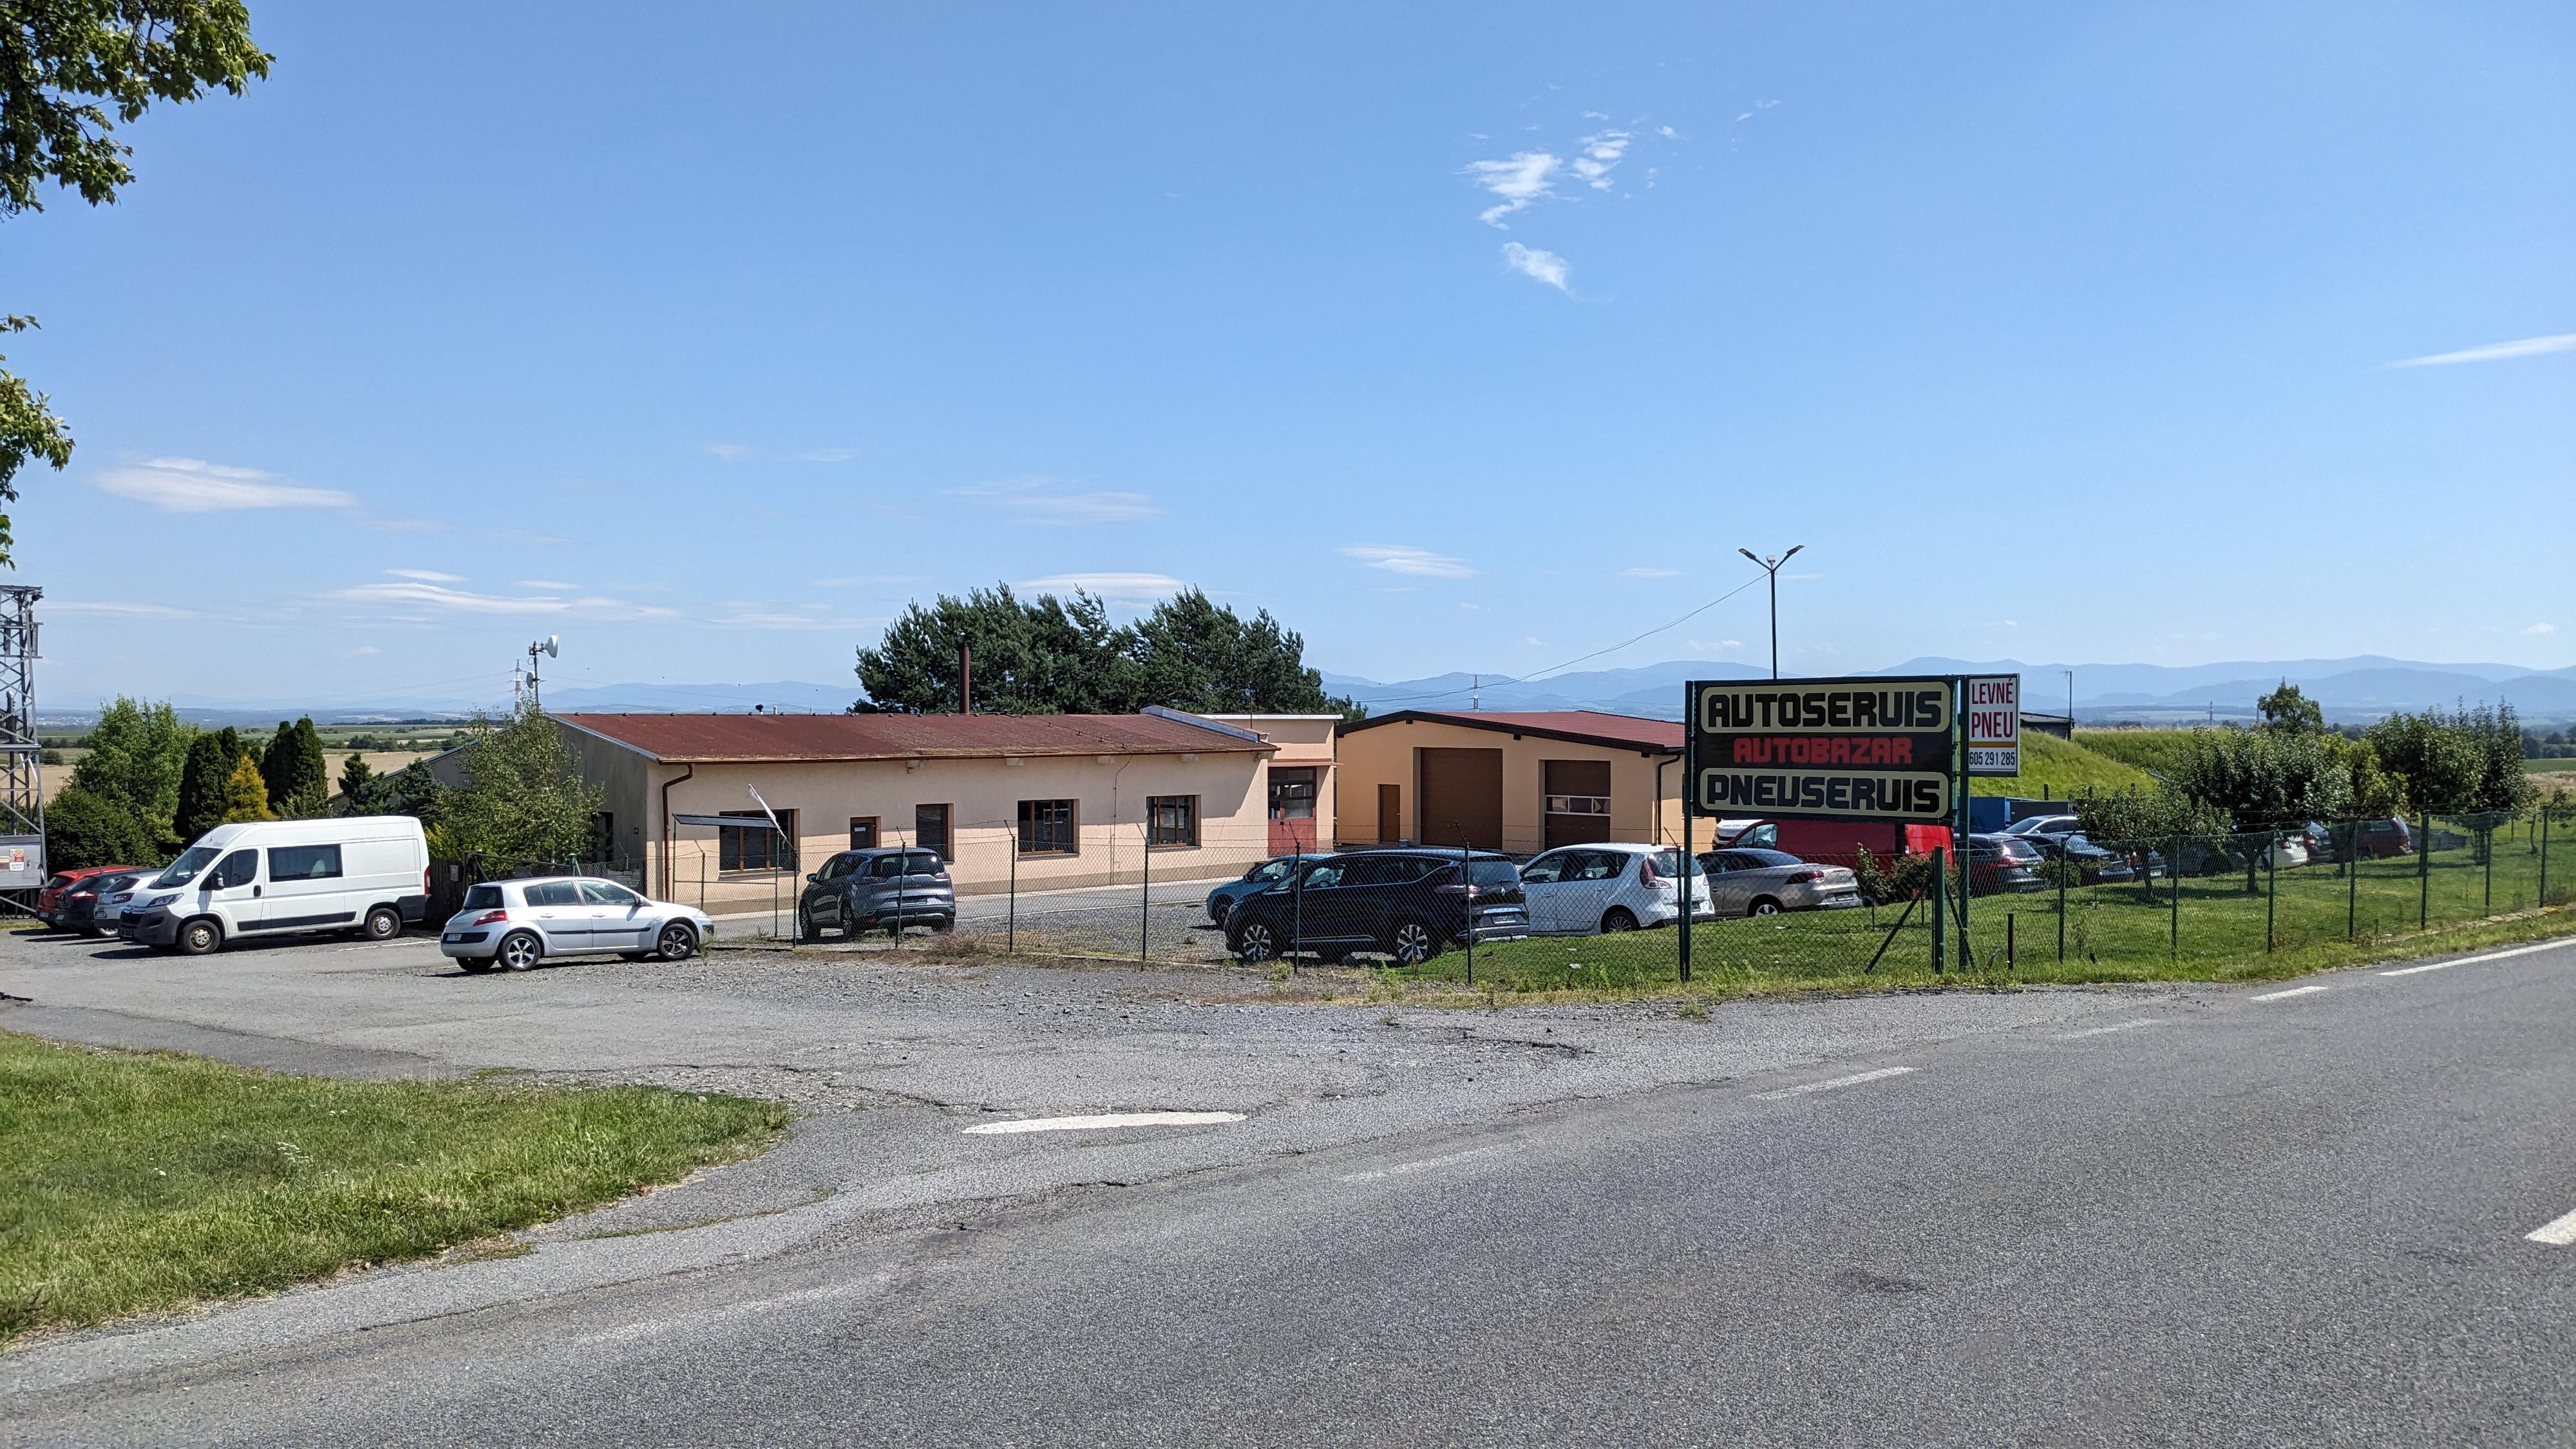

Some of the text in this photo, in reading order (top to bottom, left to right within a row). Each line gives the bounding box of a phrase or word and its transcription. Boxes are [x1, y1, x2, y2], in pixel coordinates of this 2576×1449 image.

[1971, 677, 2013, 705] LEVNÉ
[1708, 691, 1942, 728] AUTOSERVIS
[1971, 712, 2013, 738] PNEU
[1733, 736, 1913, 764] AUTOBAZAR
[1969, 752, 2015, 766] 605 291 285
[1707, 773, 1940, 813] PNEUSERVIS
